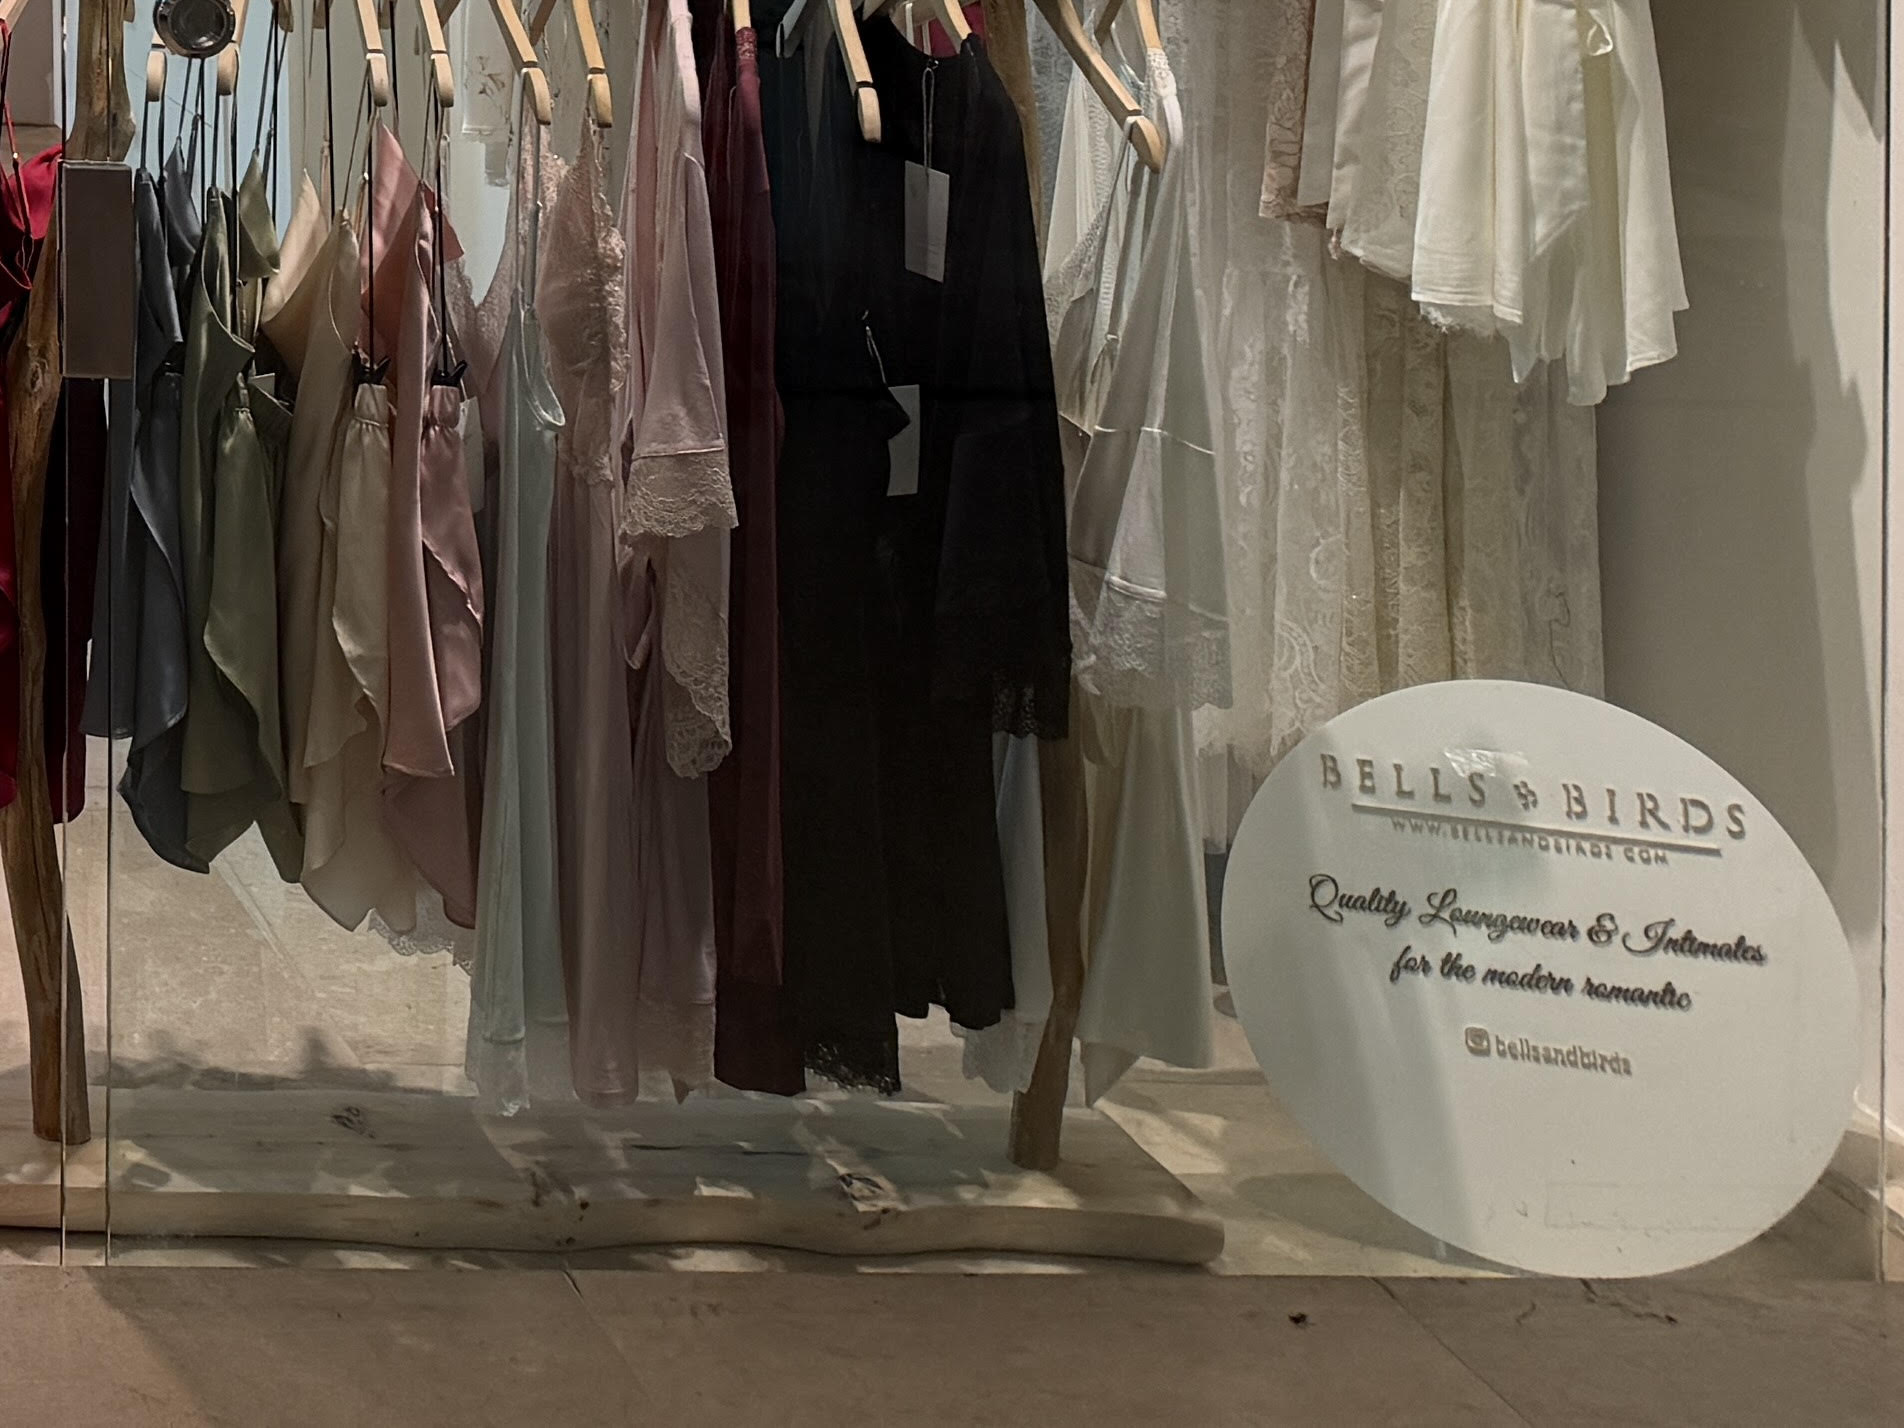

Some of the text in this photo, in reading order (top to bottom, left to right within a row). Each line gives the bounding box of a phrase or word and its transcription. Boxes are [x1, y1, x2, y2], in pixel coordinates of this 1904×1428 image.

[1320, 753, 1747, 840] BELLS BIRDS
[1309, 873, 1767, 965] Quality Loungewear & Intimates
[1389, 945, 1692, 1011] for the modern romantic
[1495, 1034, 1633, 1076] bellsandbirds
